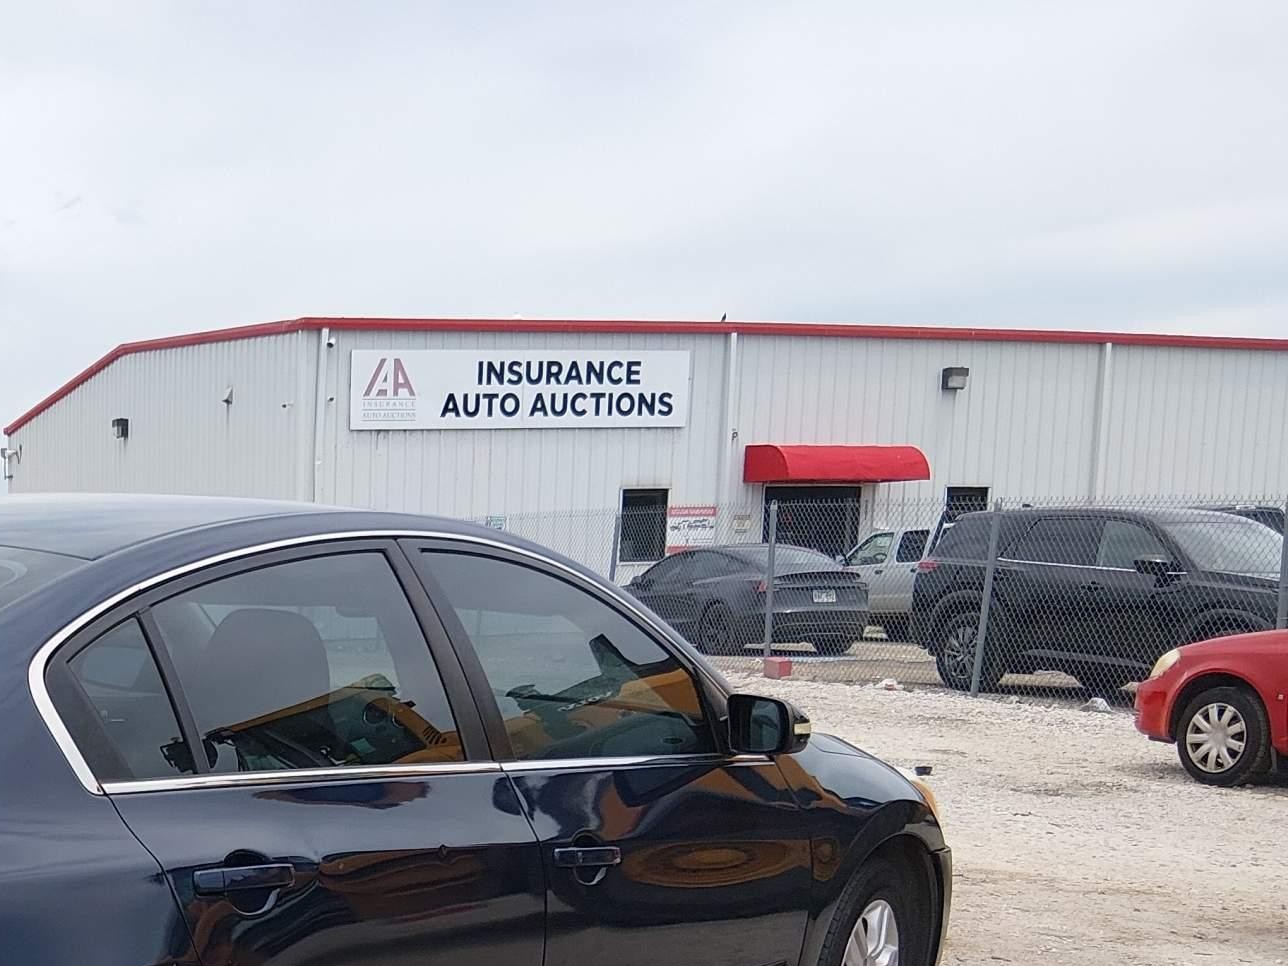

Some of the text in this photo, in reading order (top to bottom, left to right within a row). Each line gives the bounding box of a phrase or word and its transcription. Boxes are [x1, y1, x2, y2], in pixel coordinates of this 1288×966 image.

[476, 360, 642, 386] INSURANCE
[440, 392, 674, 418] AUTO AUCTIONS
